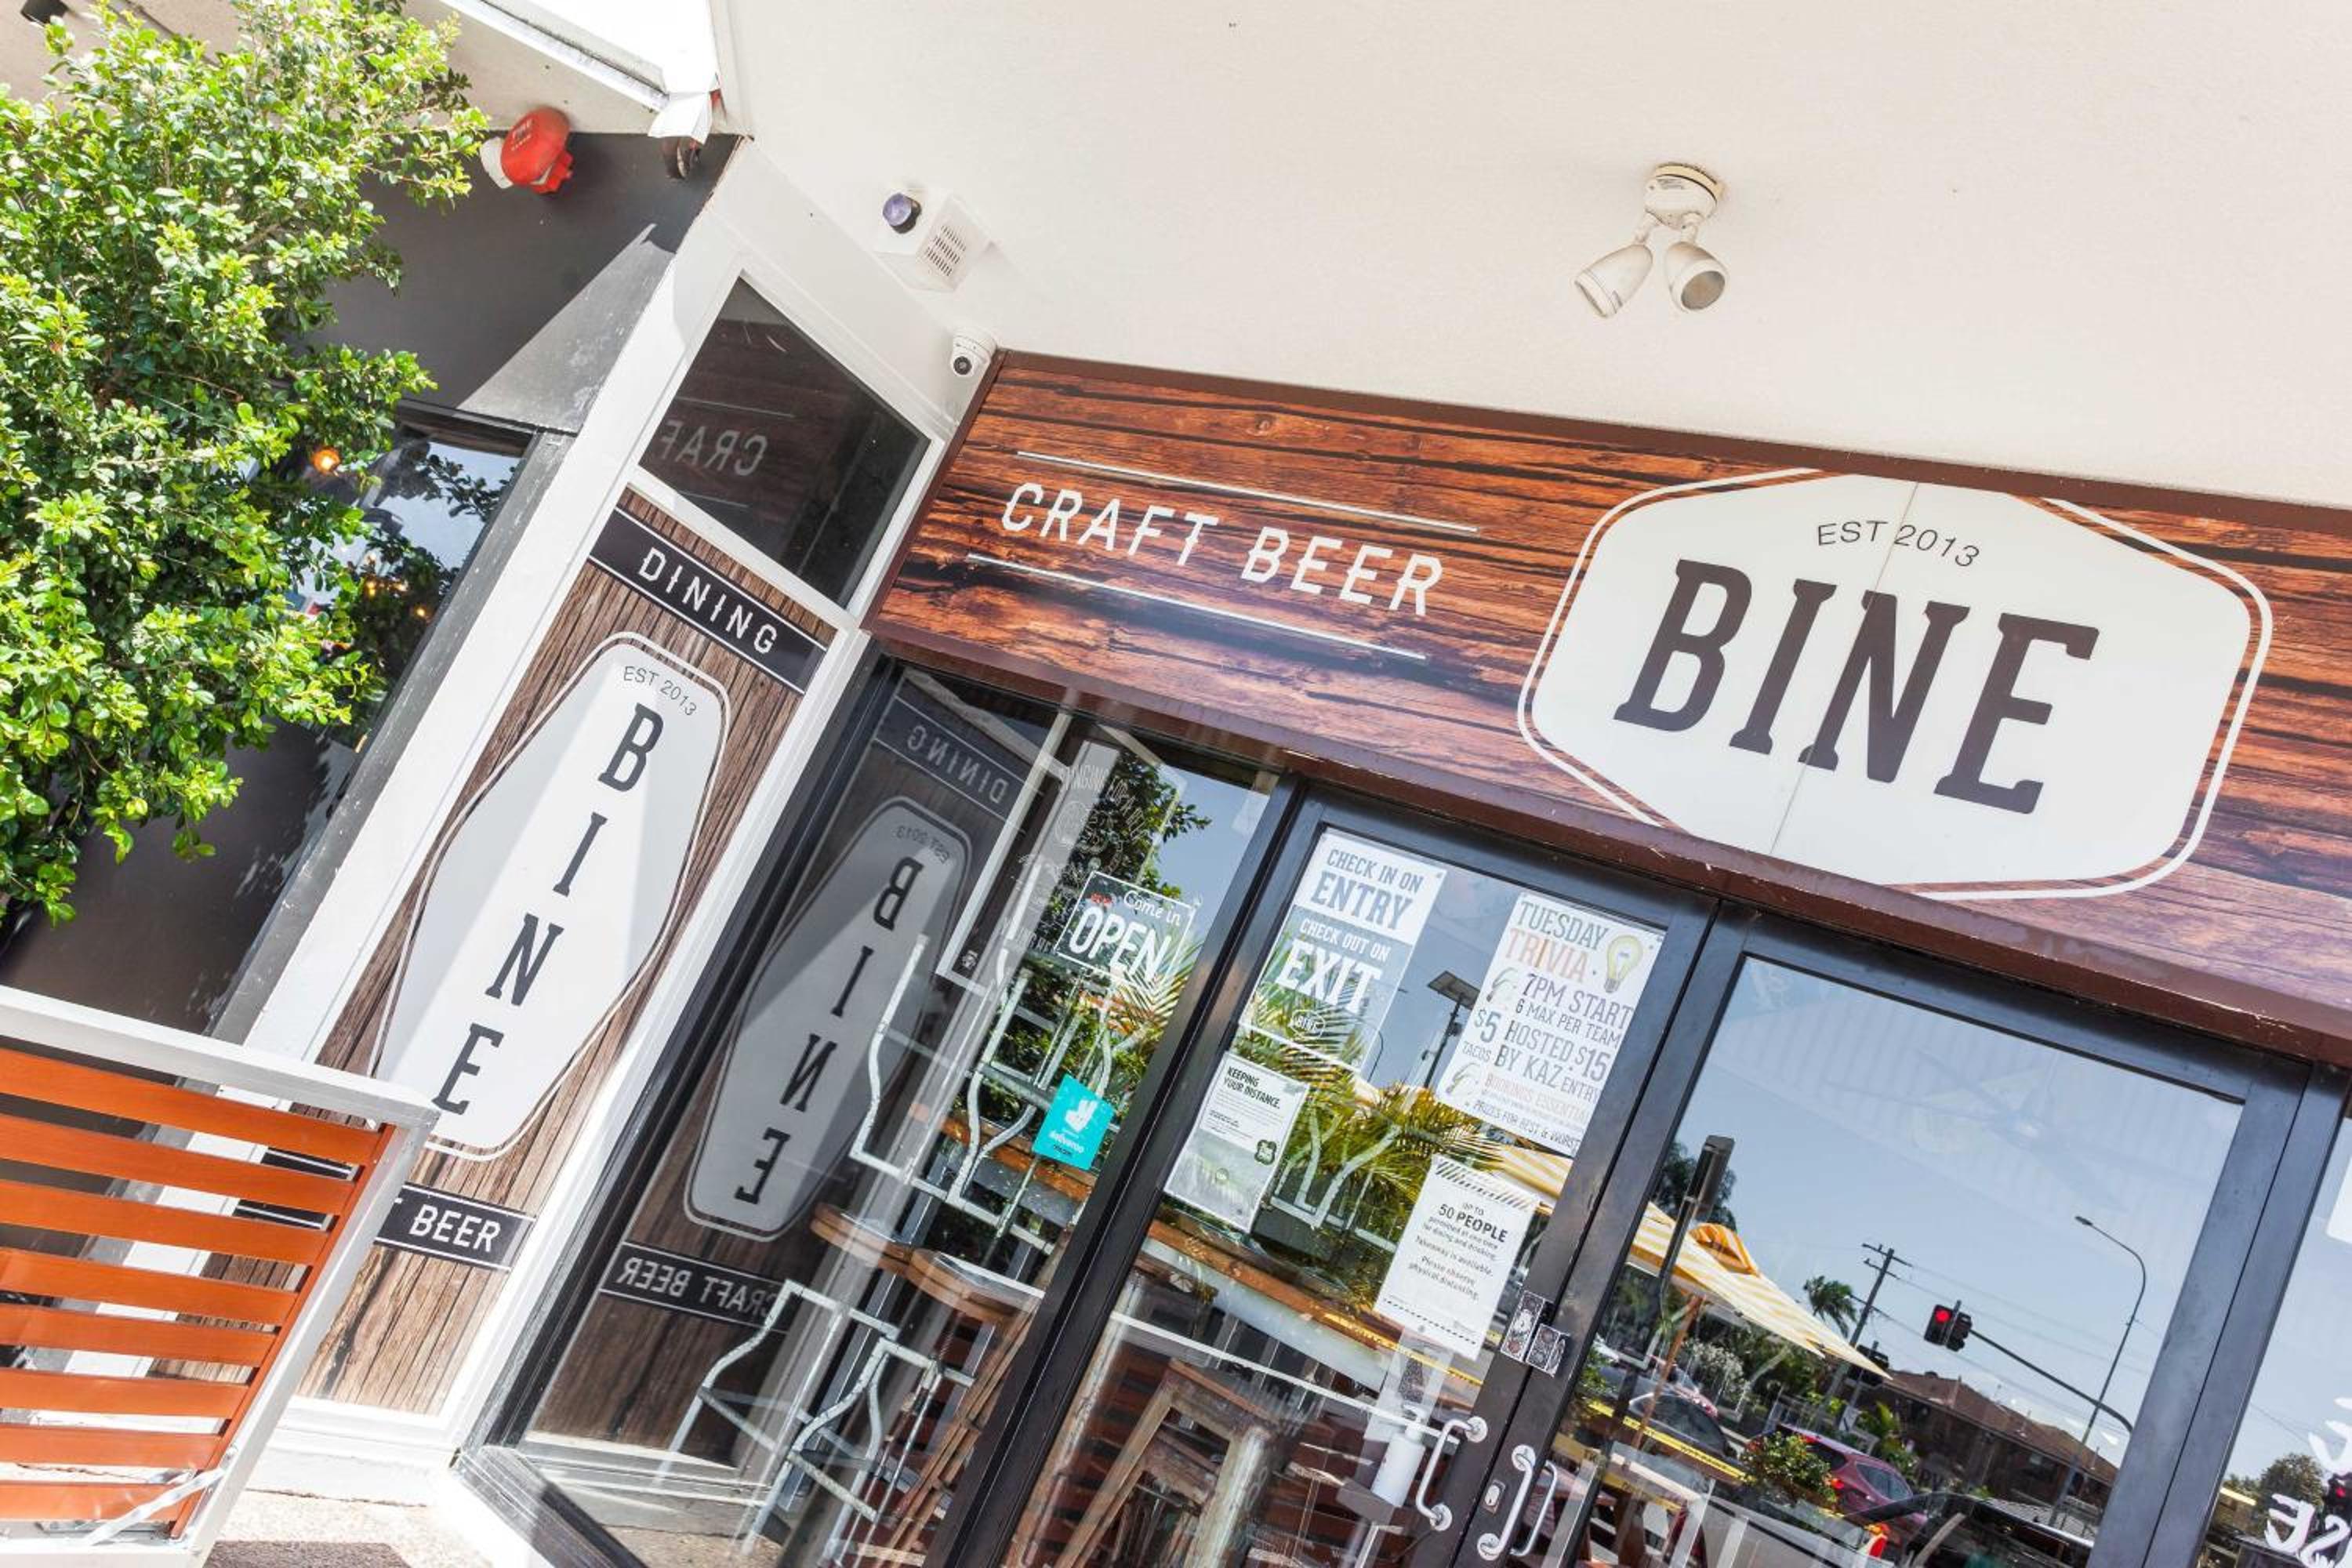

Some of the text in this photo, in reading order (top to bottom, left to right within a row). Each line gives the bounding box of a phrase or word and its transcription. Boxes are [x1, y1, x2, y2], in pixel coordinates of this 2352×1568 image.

[1001, 483, 1443, 615] CRAFT BEER
[1817, 521, 1980, 567] EST 2013
[638, 547, 777, 654] DINING
[623, 666, 697, 715] EST 2013
[1613, 559, 2100, 815] BINE
[1327, 849, 1424, 894] CHECK IN ON
[431, 702, 663, 1116] BINE
[1123, 890, 1181, 926] Come in
[1311, 870, 1414, 930] ENTRY
[1069, 906, 1172, 981] OPEN
[1299, 919, 1392, 962] CHECK OUT ON
[1517, 902, 1608, 950] TUESDAY
[1276, 938, 1383, 1014] EXIT
[1505, 927, 1588, 980] TRIVIA
[1523, 973, 1634, 1030] 7PM START
[1473, 1008, 1501, 1043] $5
[1505, 1020, 1573, 1062] HOSTED
[1527, 1005, 1555, 1026] MAX
[1557, 1013, 1580, 1033] PER
[1585, 1022, 1621, 1049] TEAM
[1462, 1040, 1491, 1064] TACOS
[1494, 1044, 1563, 1089] BY KAZ
[1574, 1045, 1611, 1082] $15
[1223, 1077, 1246, 1095] YOUR
[1227, 1066, 1260, 1087] KEEPING
[1560, 1075, 1599, 1102] ENTRY
[409, 1204, 501, 1253] BEER
[1439, 1203, 1508, 1243] 50 PEOPLE
